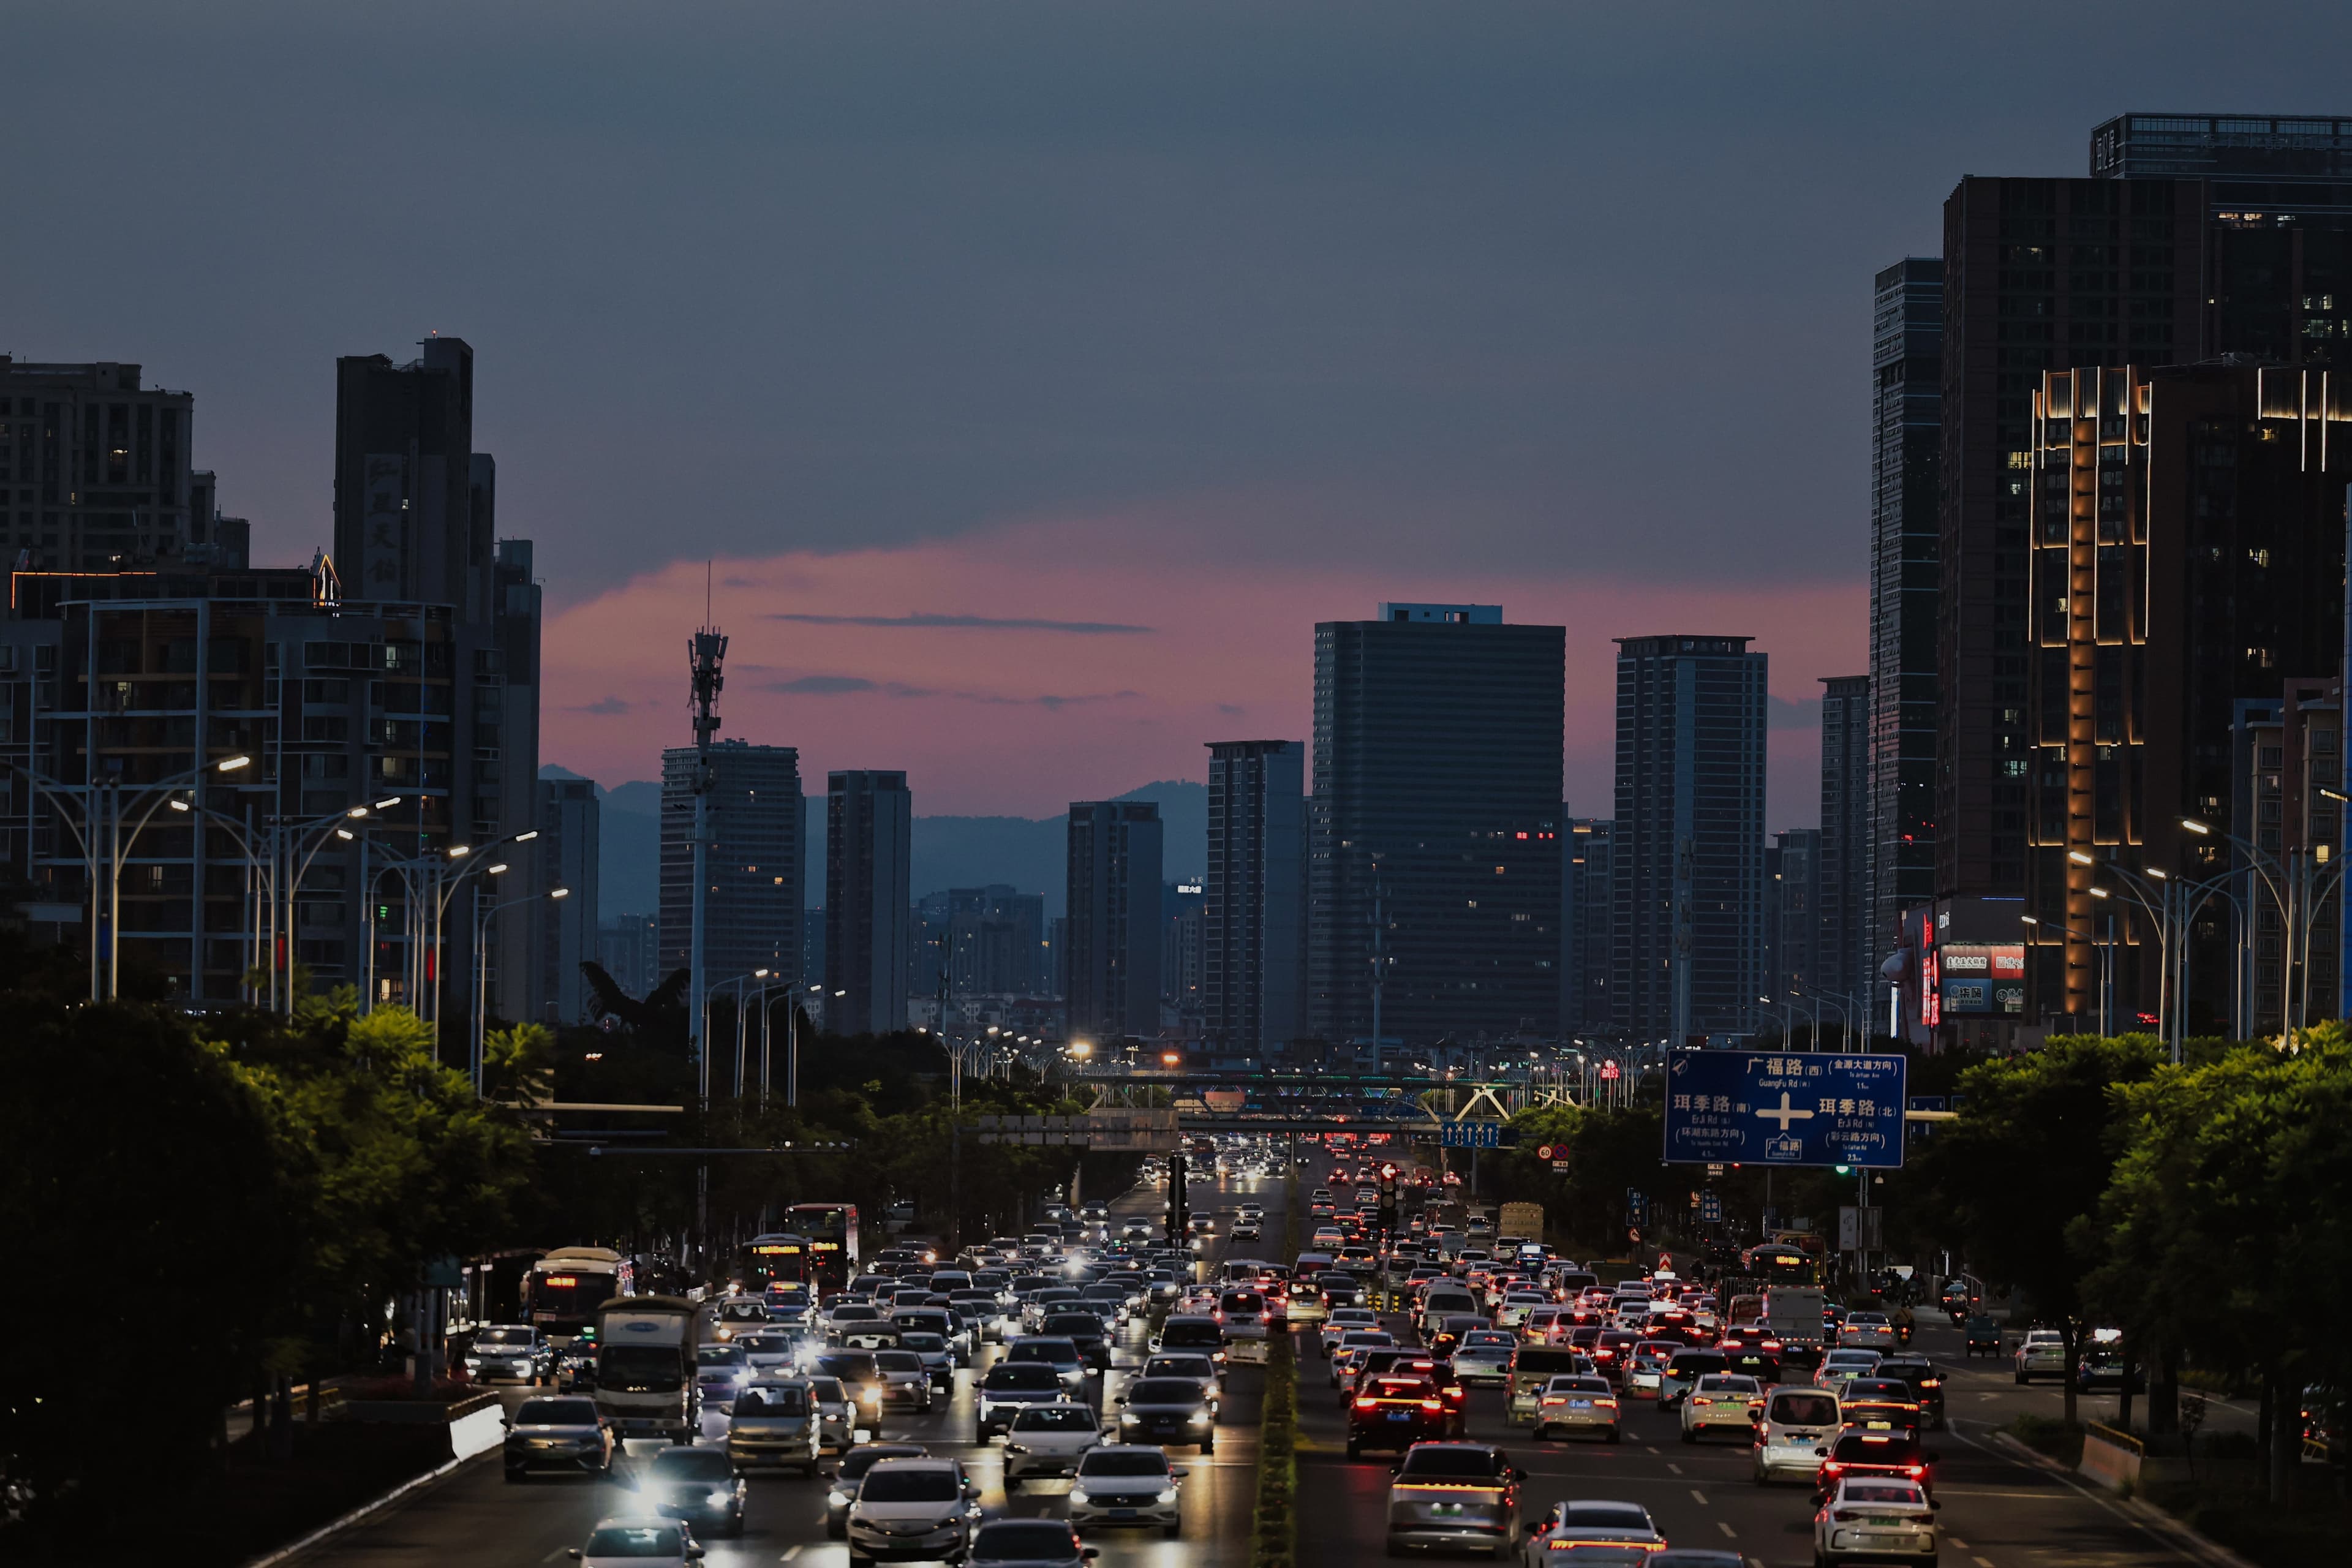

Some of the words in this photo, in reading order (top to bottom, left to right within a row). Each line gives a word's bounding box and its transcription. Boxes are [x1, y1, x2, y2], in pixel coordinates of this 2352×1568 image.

[1759, 1079, 1787, 1090] GuangFu
[1789, 1079, 1798, 1088] Rd
[1708, 1114, 1717, 1124] Rd
[1853, 1118, 1863, 1128] Rd
[1768, 1140, 1799, 1152] 广福路
